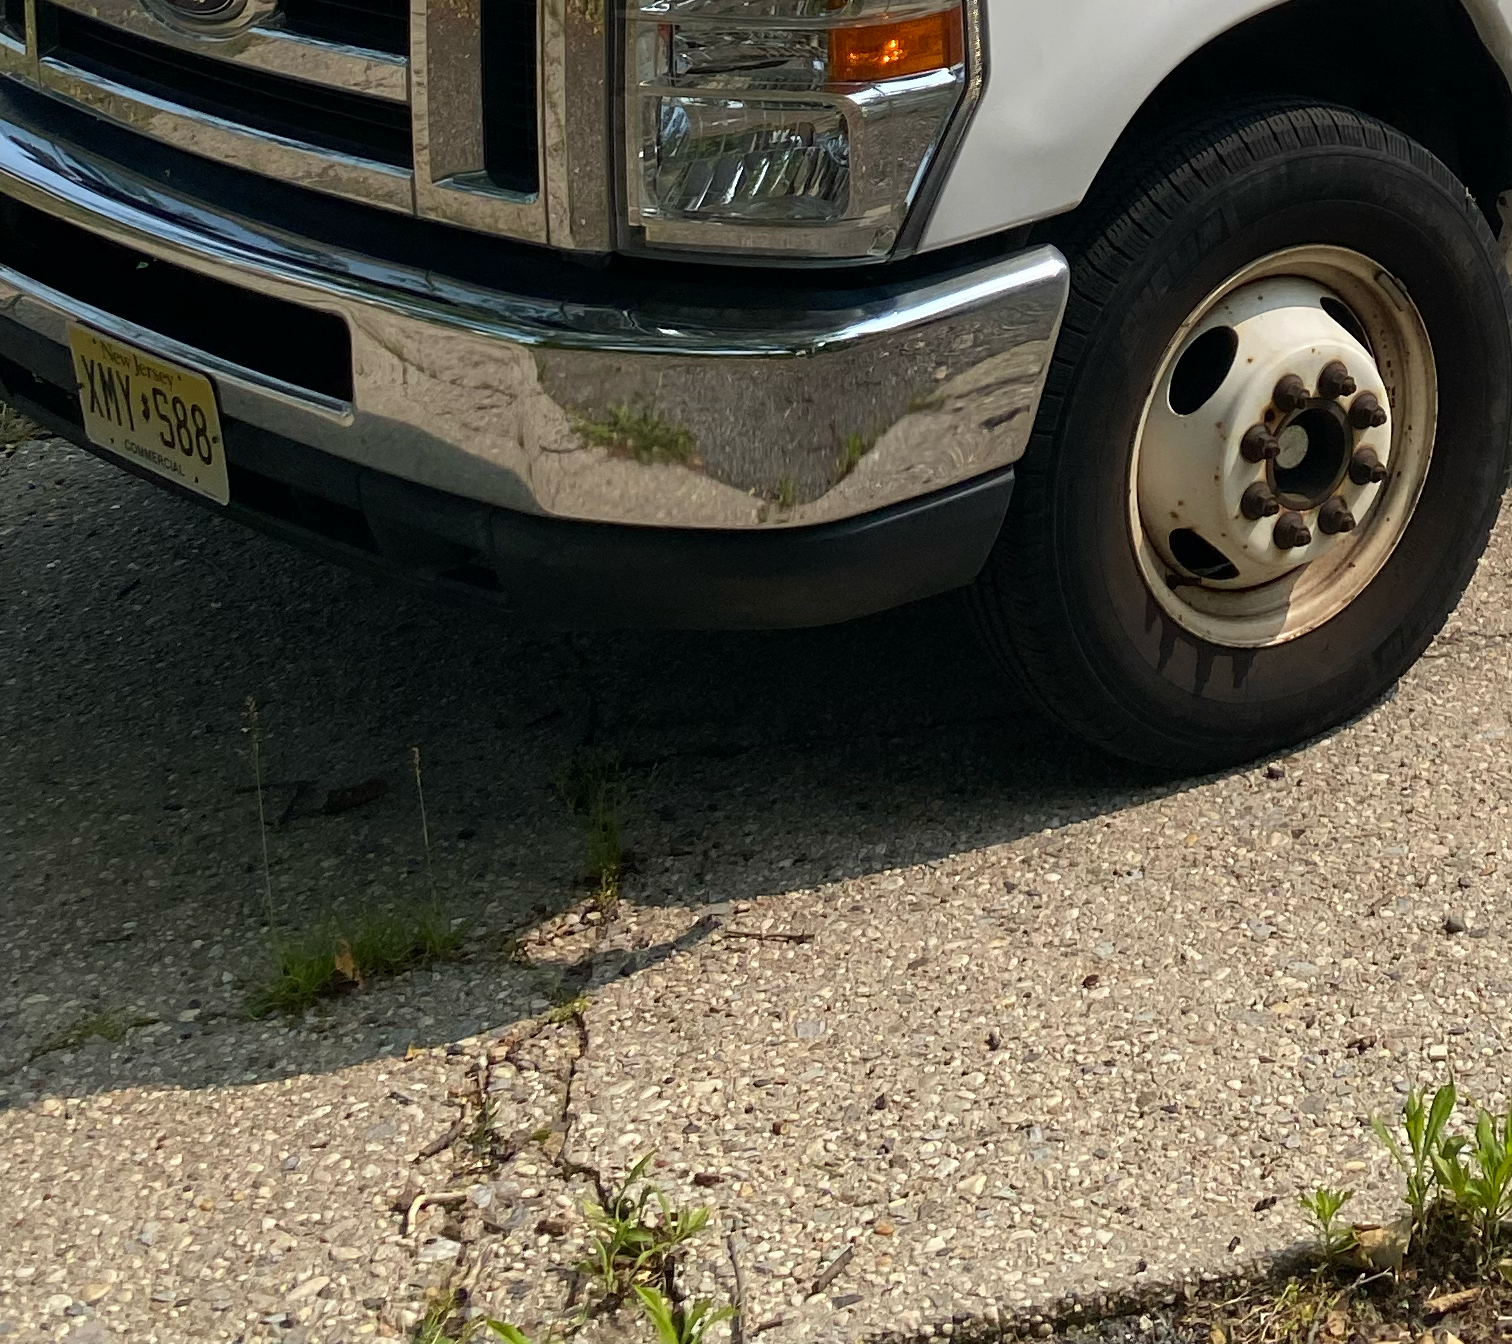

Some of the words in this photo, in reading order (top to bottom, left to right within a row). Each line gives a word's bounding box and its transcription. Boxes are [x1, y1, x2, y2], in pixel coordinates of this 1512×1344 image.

[100, 340, 131, 370] New
[132, 353, 174, 391] Jersey
[123, 438, 186, 477] COMMERCIAL
